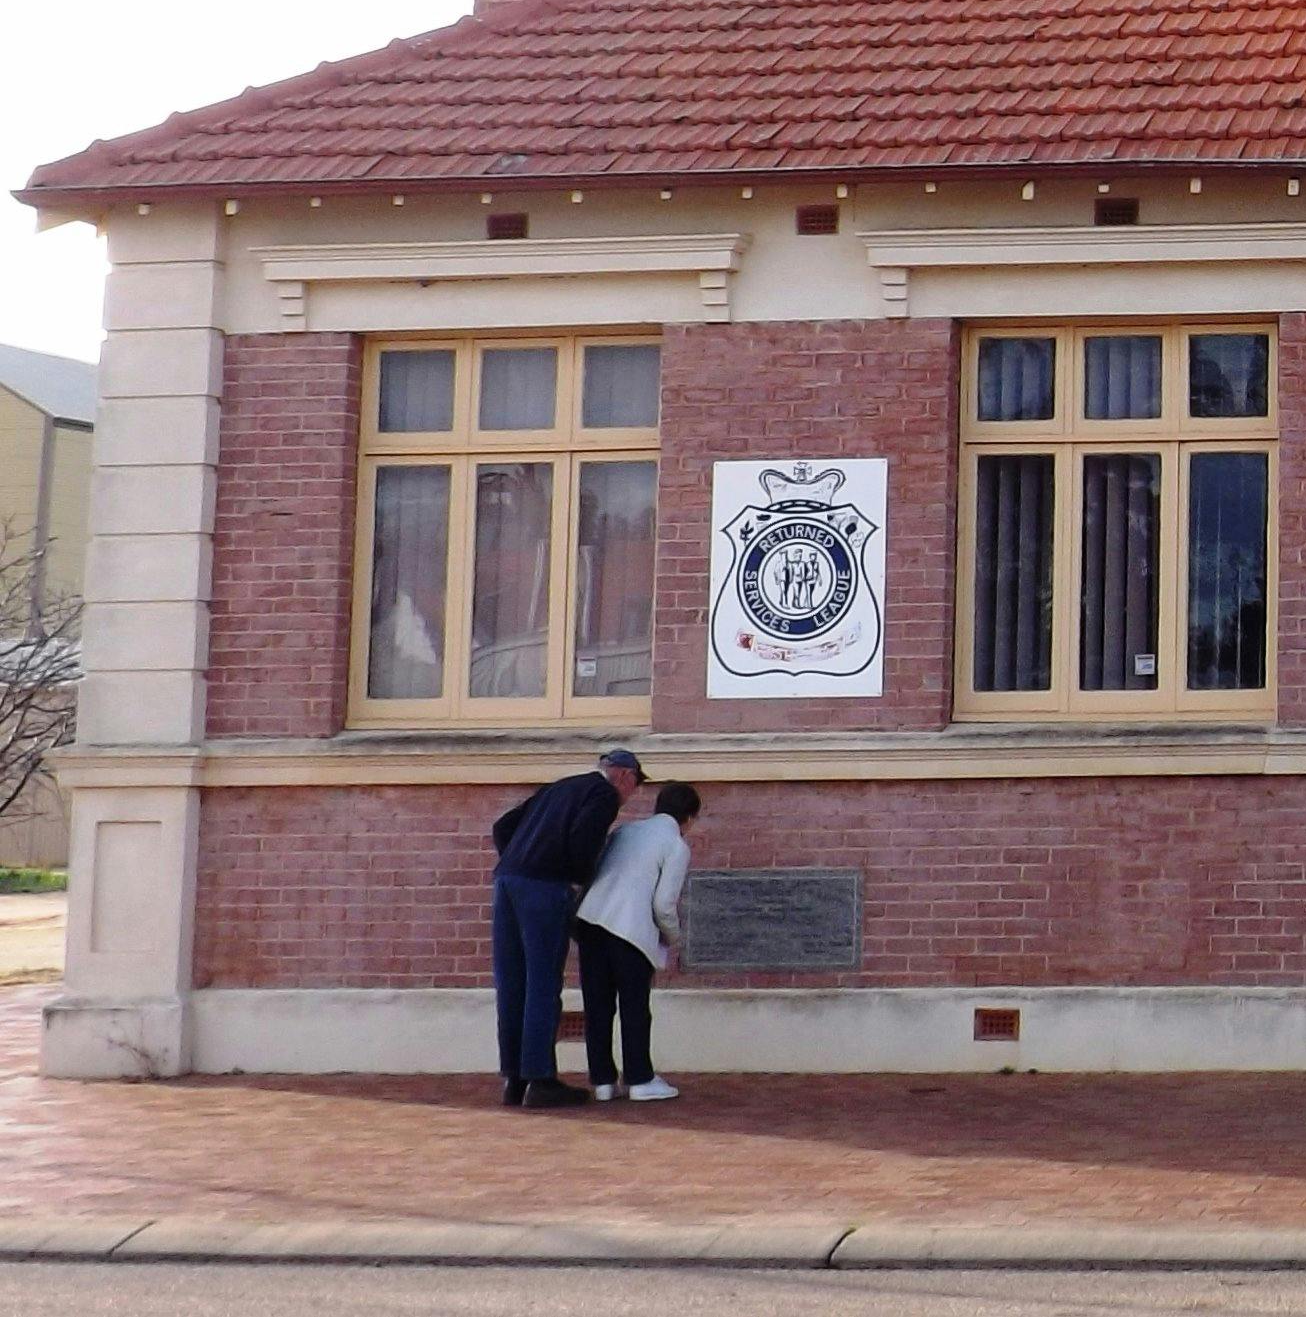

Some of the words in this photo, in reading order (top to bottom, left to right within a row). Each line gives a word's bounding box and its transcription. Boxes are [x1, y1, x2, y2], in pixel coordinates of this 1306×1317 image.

[758, 525, 835, 553] RETURNED
[745, 570, 790, 632] SERVICES
[813, 570, 850, 628] LEAGUE
